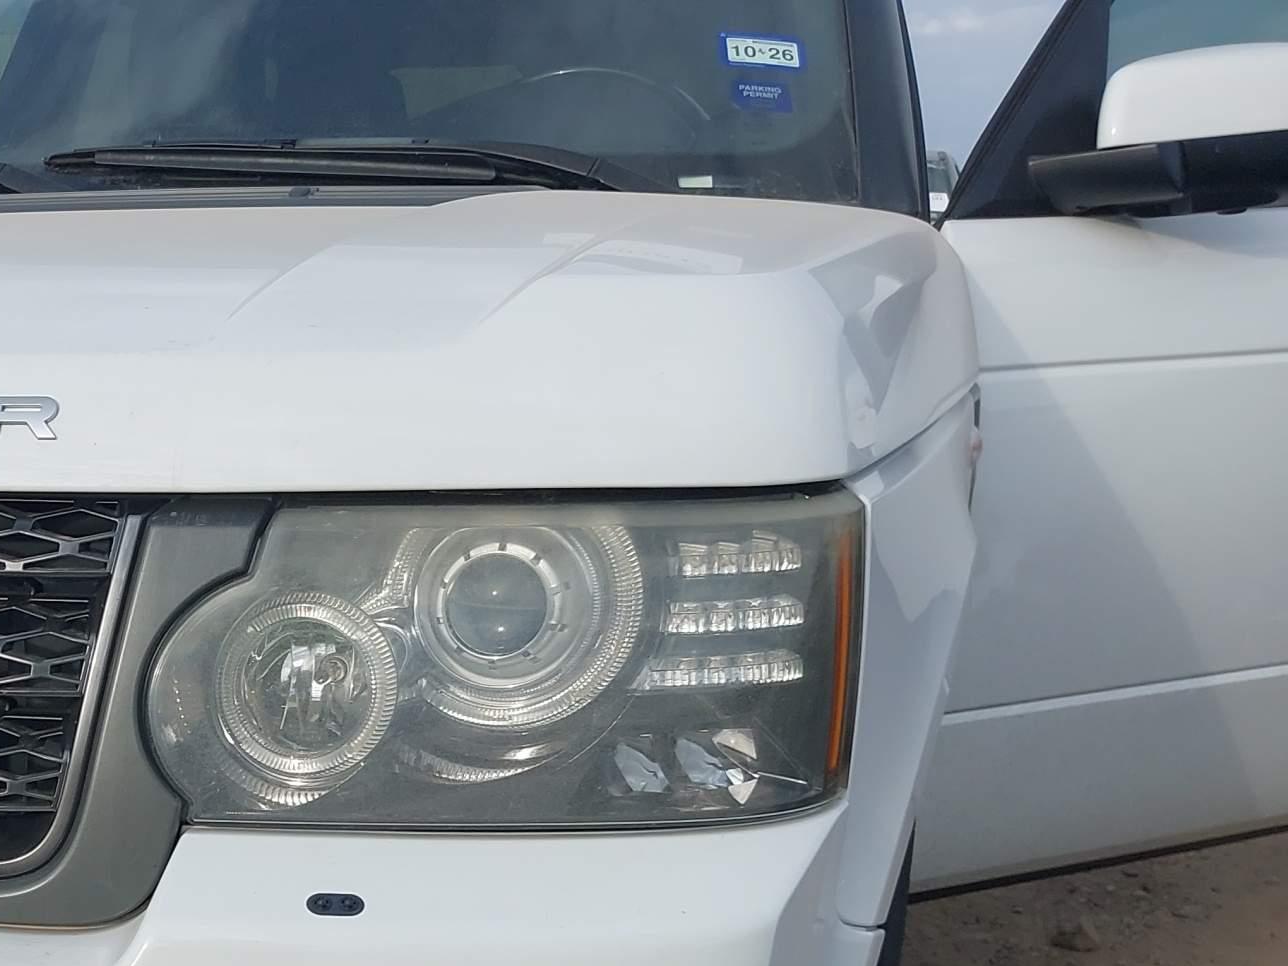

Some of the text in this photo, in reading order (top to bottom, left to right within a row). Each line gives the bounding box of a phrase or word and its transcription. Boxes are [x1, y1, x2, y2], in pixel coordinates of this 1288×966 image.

[730, 44, 757, 58] 10
[767, 47, 795, 62] 26
[738, 84, 782, 94] PARKING
[743, 90, 779, 100] PERMIT
